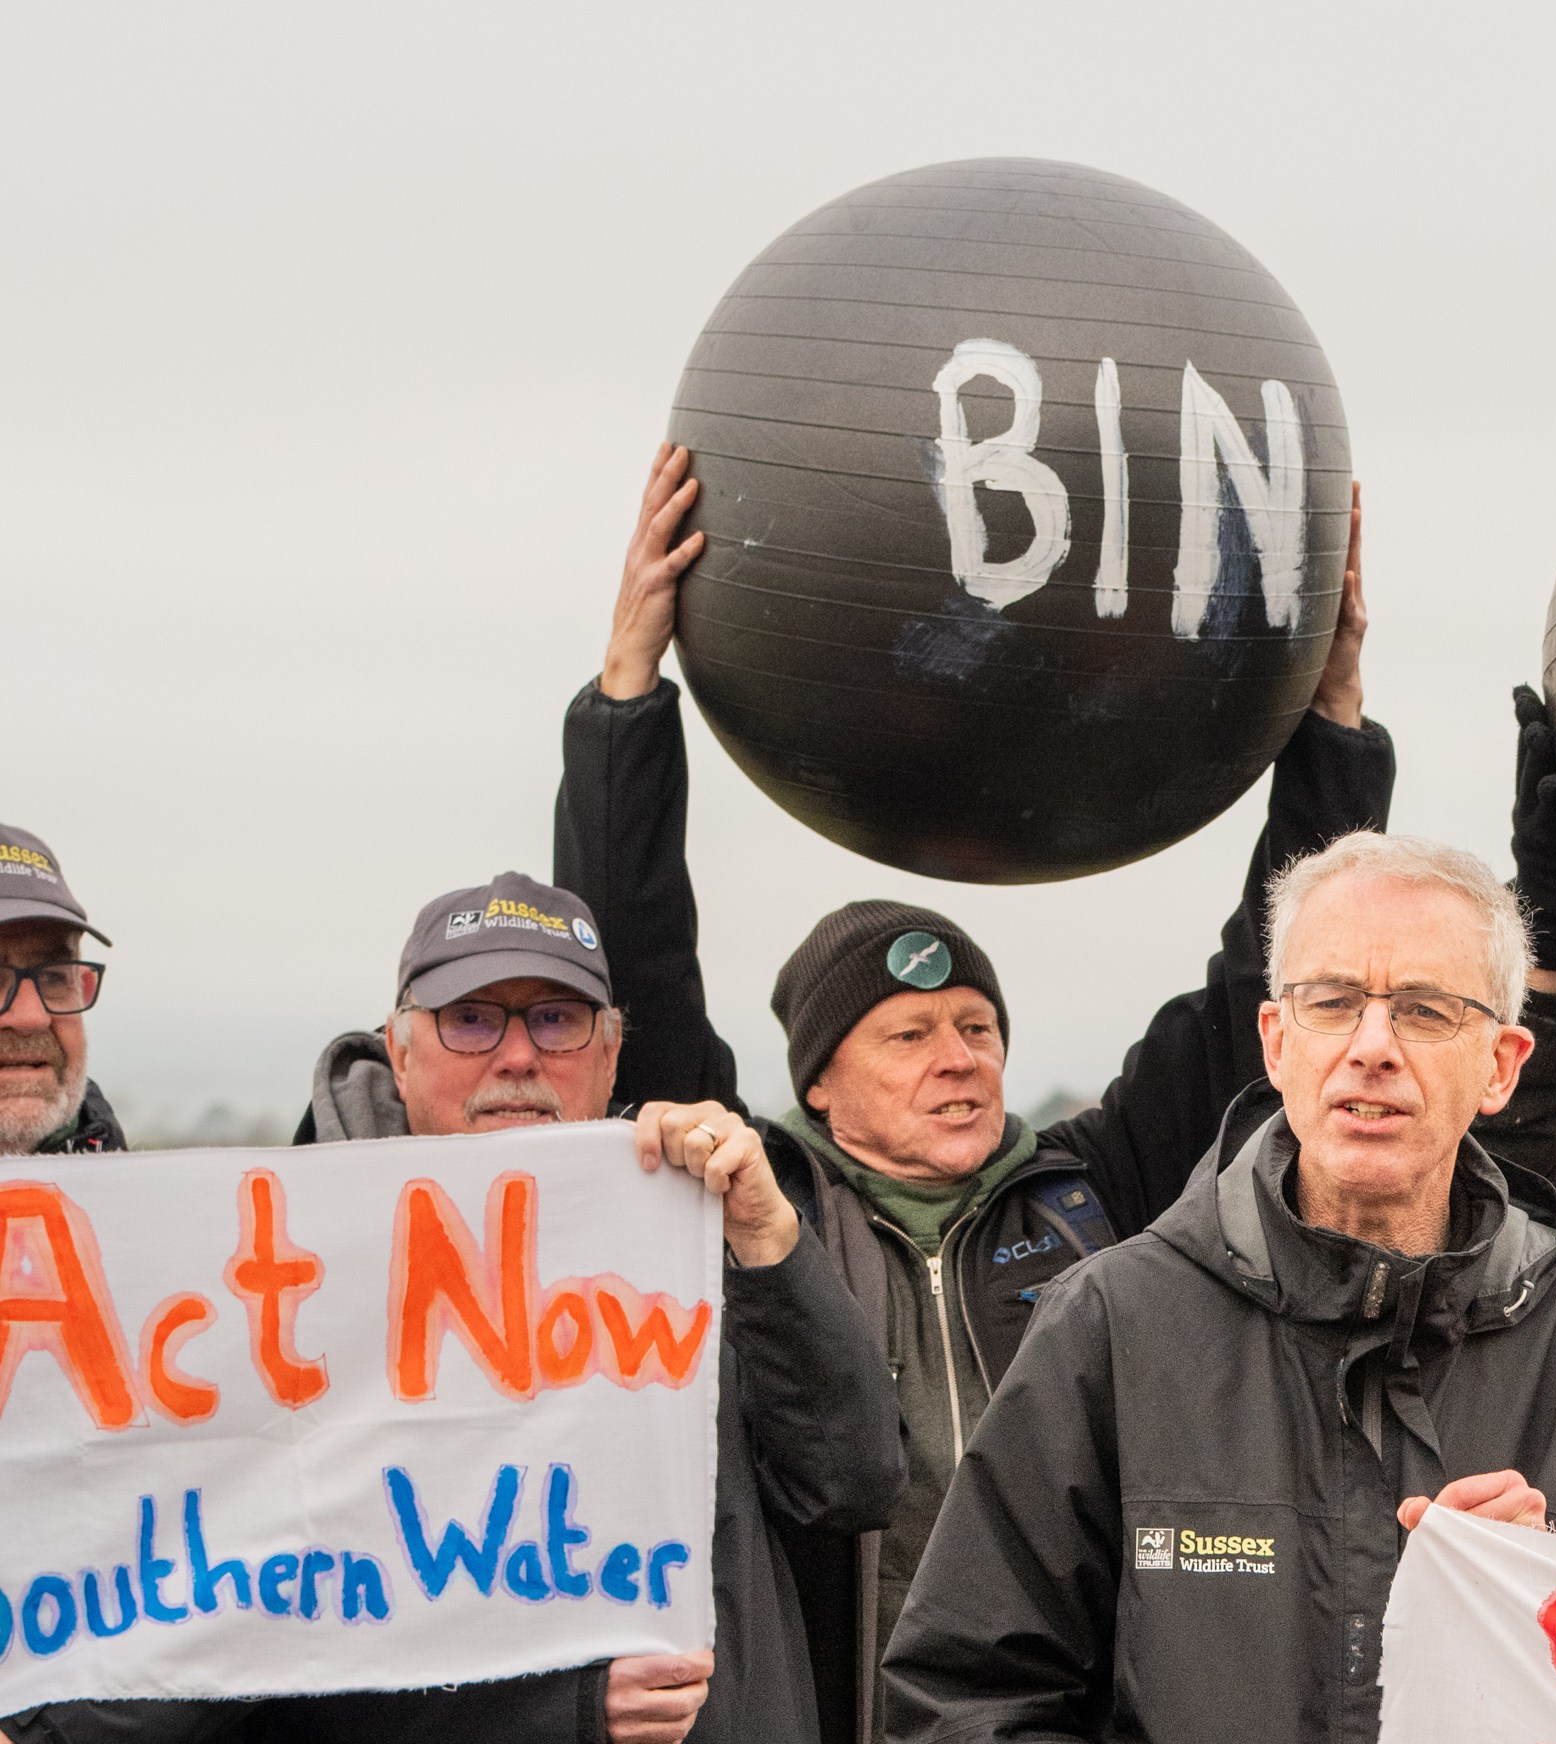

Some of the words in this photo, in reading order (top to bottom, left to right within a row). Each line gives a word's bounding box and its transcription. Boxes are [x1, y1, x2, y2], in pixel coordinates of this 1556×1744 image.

[931, 337, 1308, 641] BIN
[484, 915, 540, 932] Wildlife
[485, 898, 569, 931] Sussex
[0, 1167, 329, 1433] Act
[388, 1169, 712, 1403] Now
[382, 1462, 694, 1612] Water
[1179, 1529, 1276, 1557] Sussex
[1138, 1548, 1171, 1560] wildlife
[1179, 1556, 1234, 1573] Wildlife
[1235, 1557, 1276, 1574] Trust
